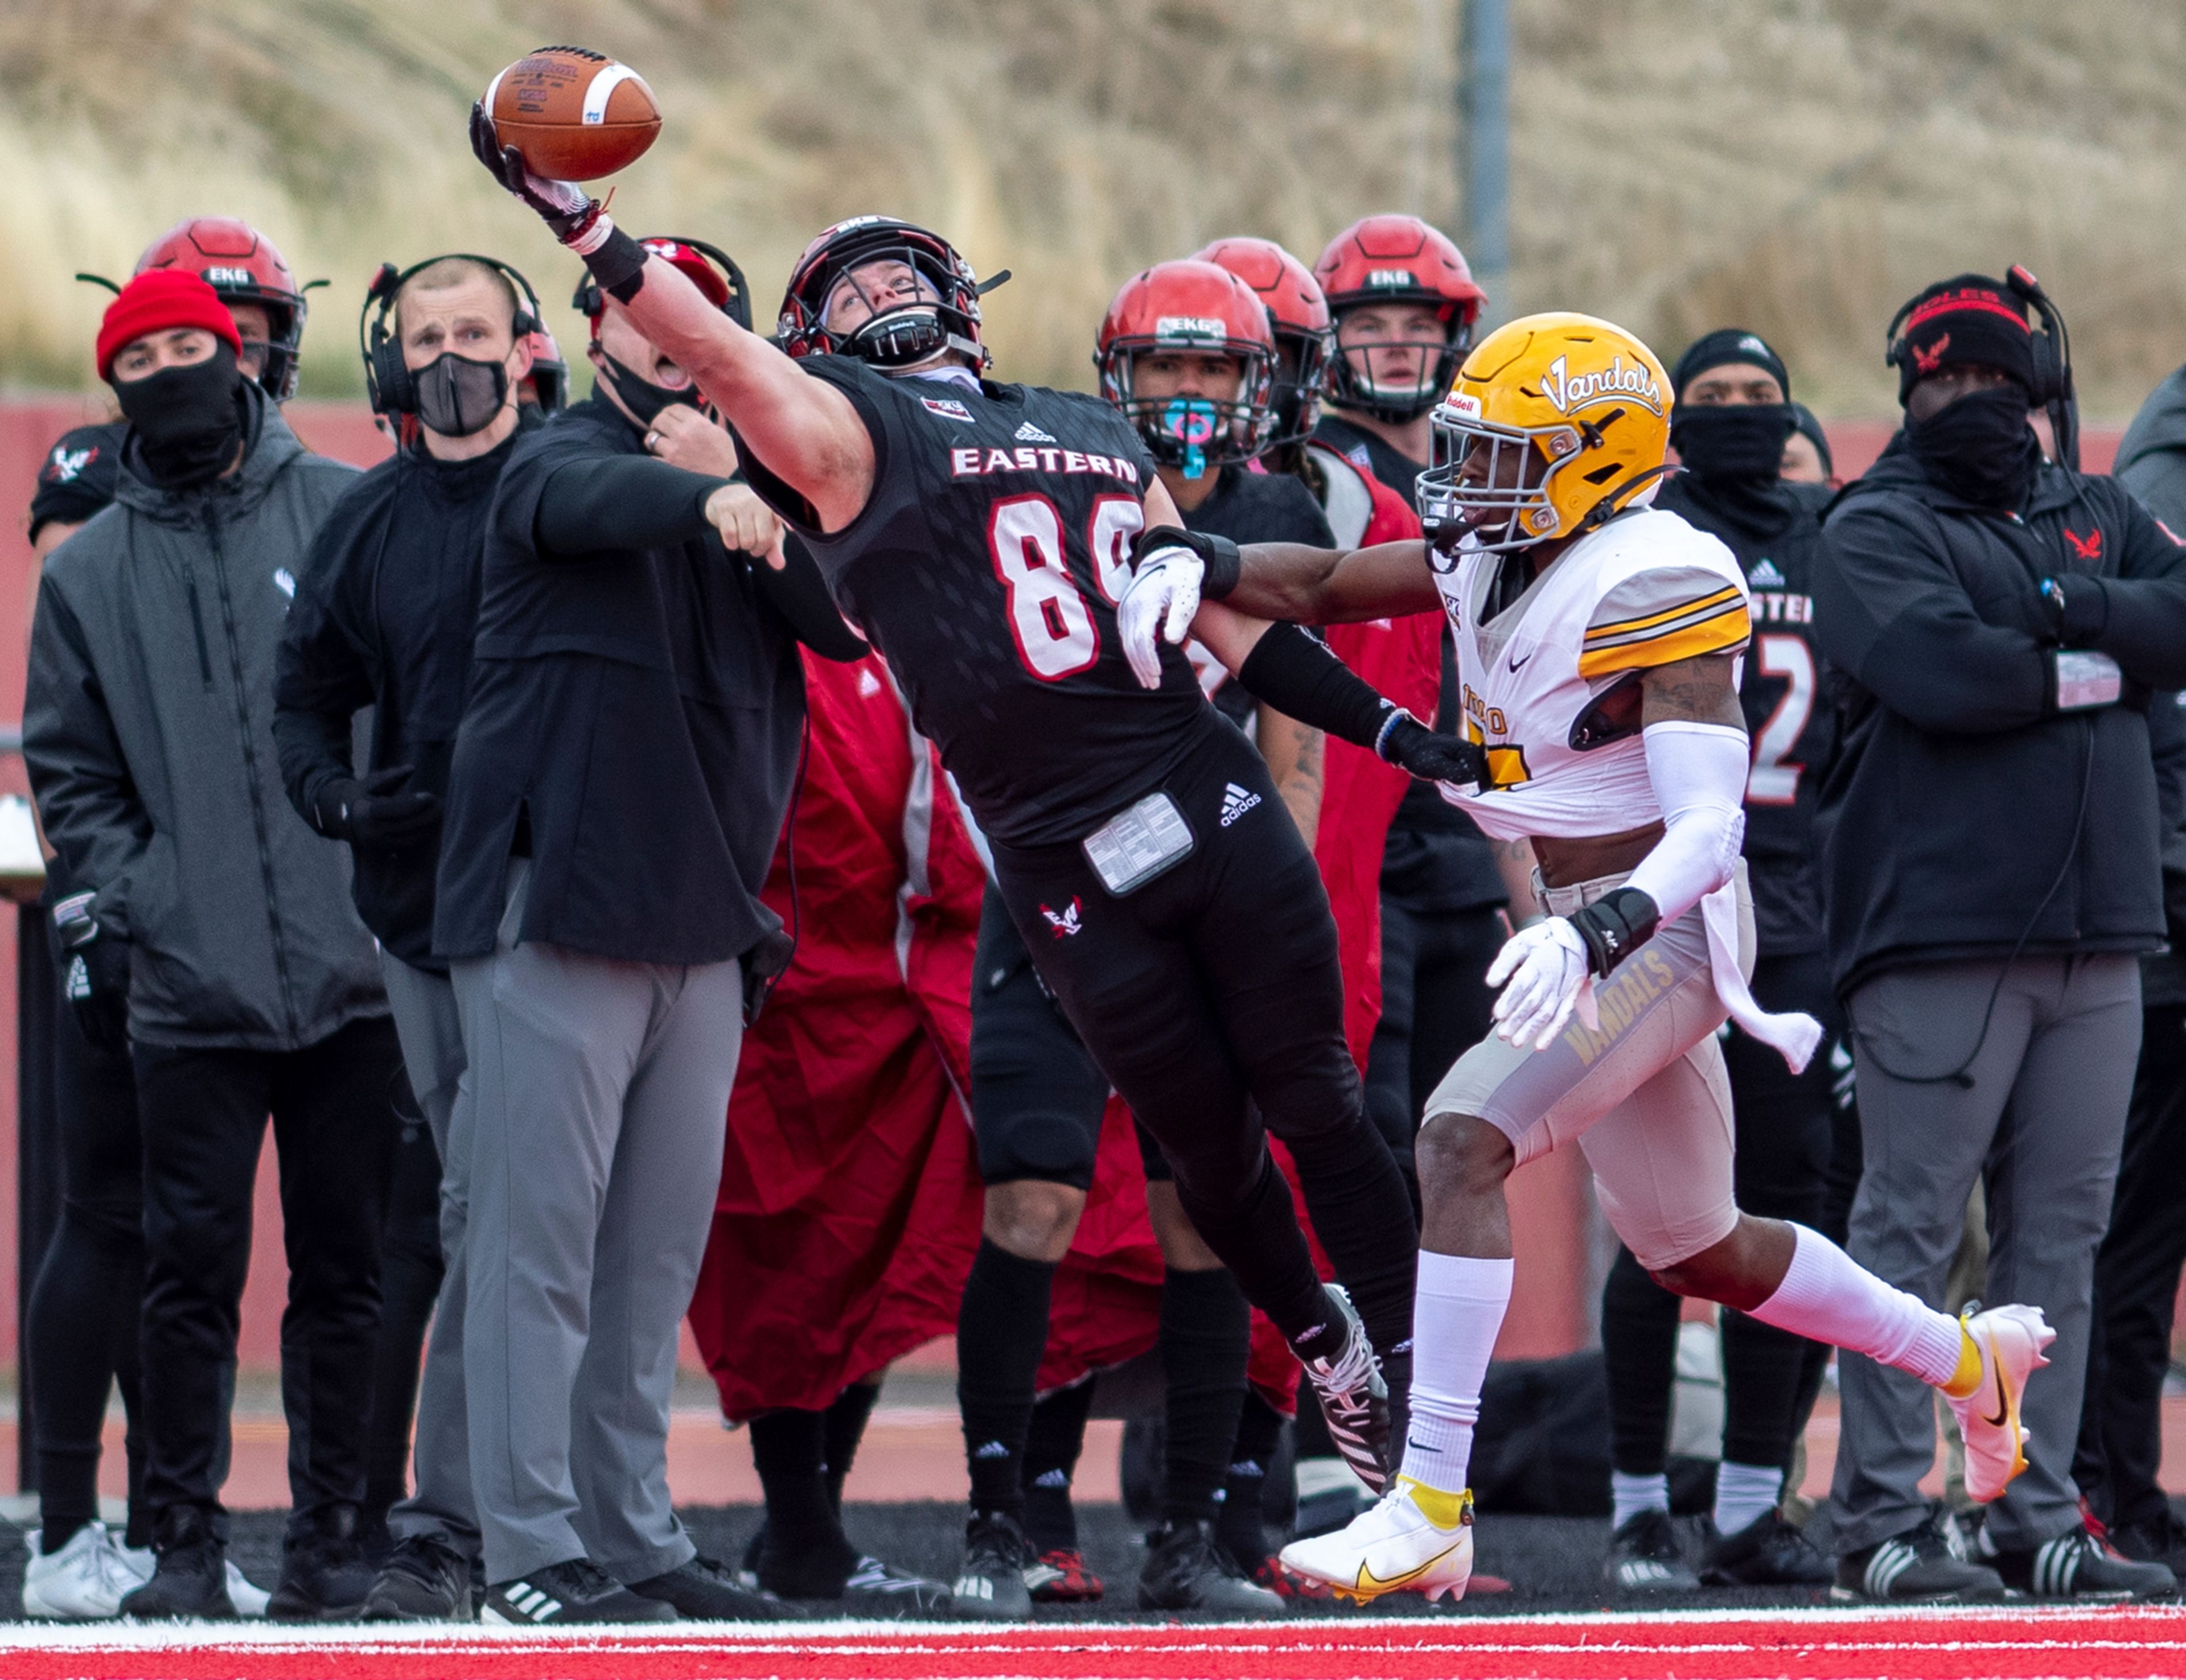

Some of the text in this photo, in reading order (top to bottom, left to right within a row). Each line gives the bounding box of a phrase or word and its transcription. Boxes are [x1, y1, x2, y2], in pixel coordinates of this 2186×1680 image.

[209, 267, 249, 282] EKG
[1370, 270, 1409, 285] EKG
[1173, 317, 1210, 332] EKG
[1539, 354, 1663, 418] Vandals
[951, 448, 1137, 483] EASTERN
[1221, 793, 1262, 827] adidas
[1563, 949, 1674, 1068] VANDALS
